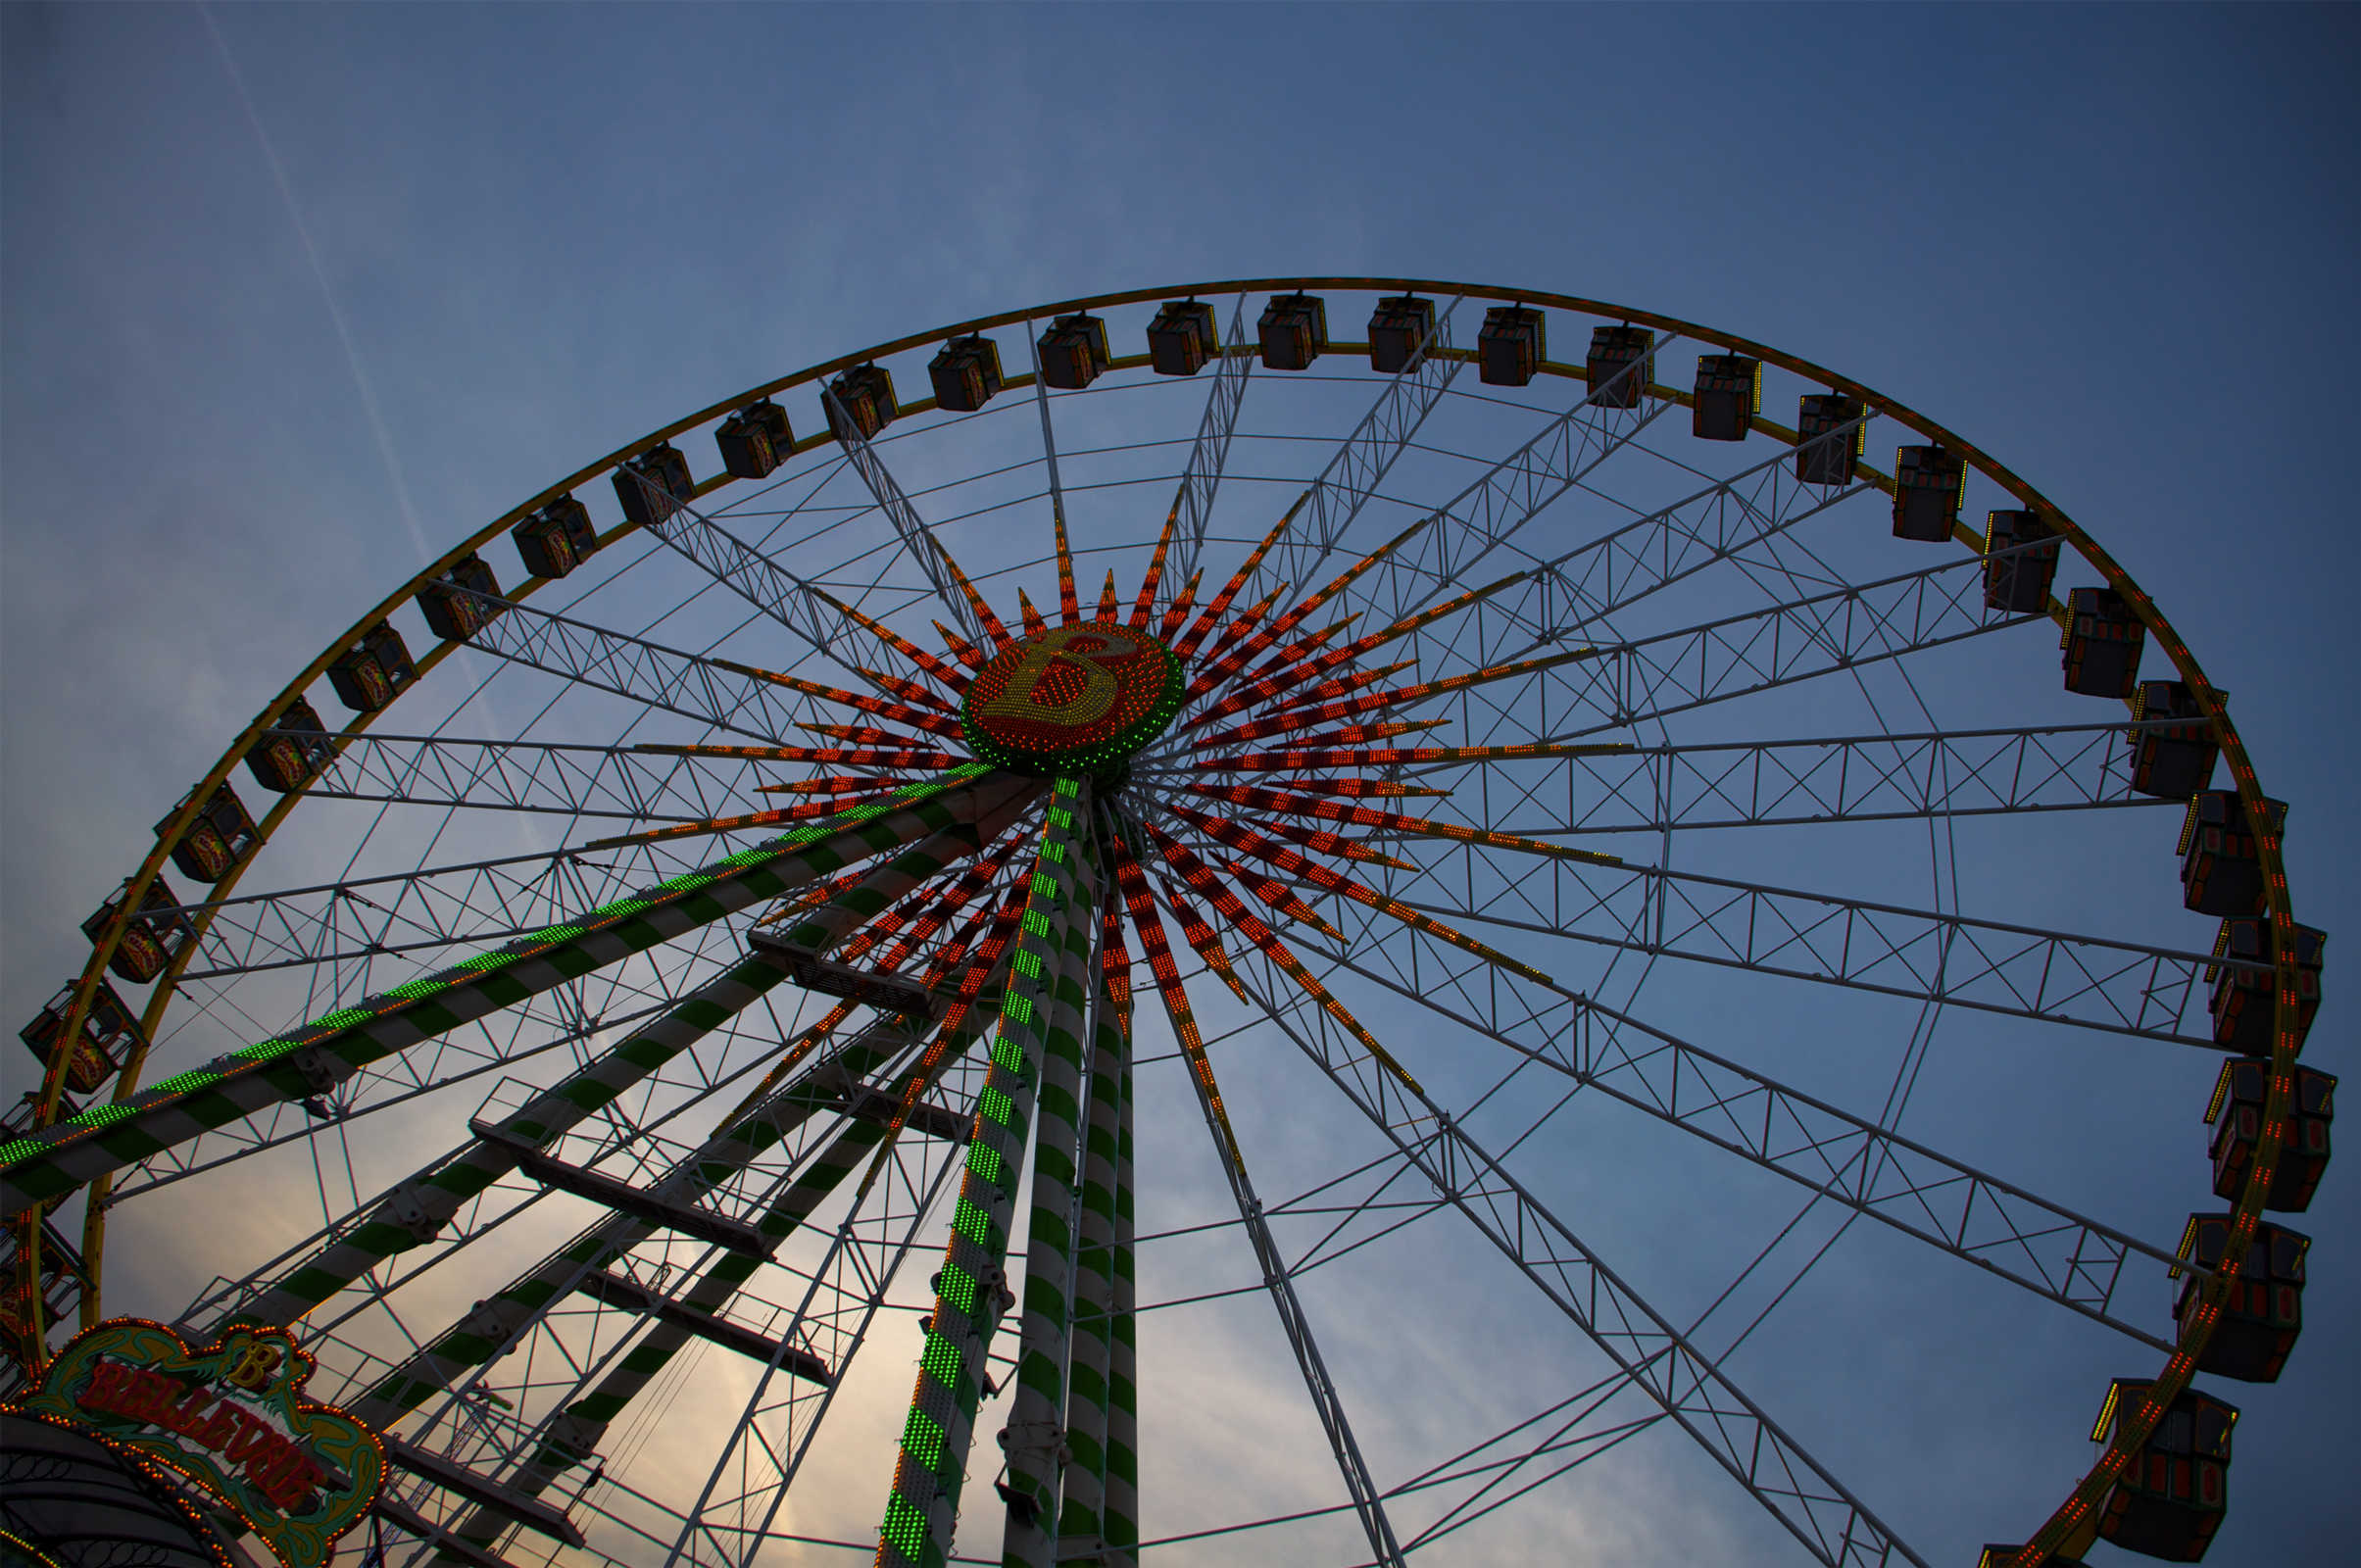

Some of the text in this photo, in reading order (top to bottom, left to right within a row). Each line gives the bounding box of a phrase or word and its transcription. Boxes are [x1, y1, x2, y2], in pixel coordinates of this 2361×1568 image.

[981, 630, 1139, 728] B
[226, 1341, 283, 1391] B
[76, 1363, 327, 1510] BELLEVUE
